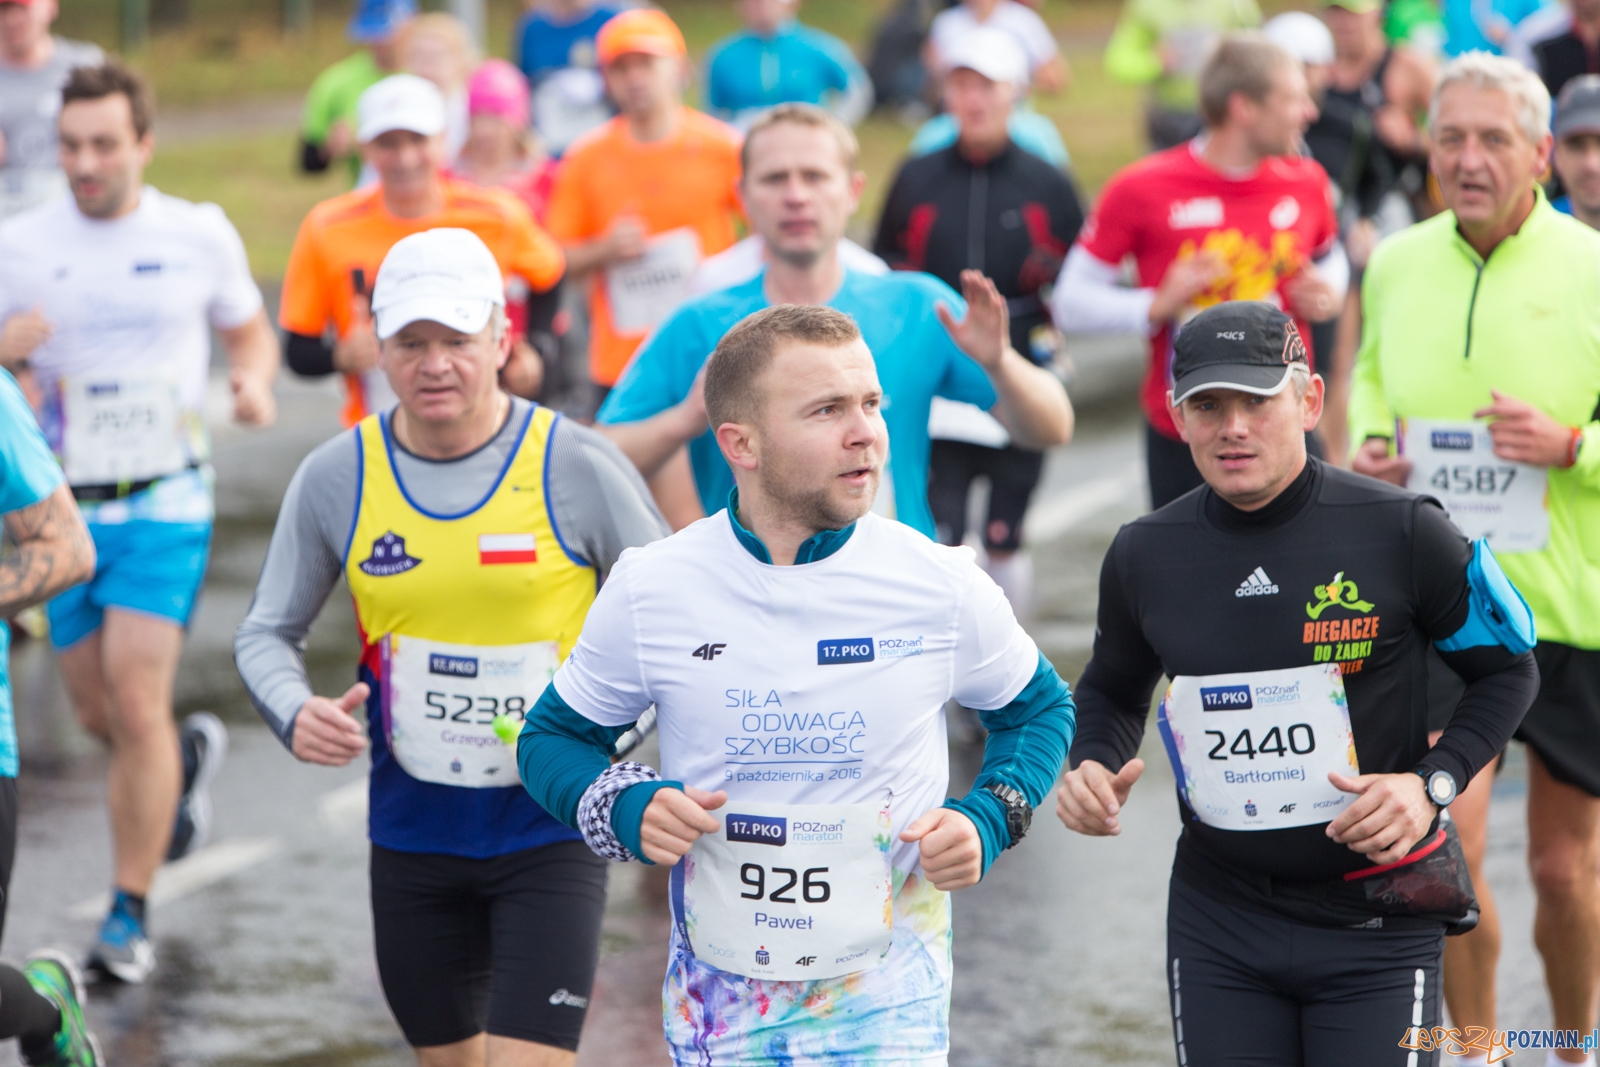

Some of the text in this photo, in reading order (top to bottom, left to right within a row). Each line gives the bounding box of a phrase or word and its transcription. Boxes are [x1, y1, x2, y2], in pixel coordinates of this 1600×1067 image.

[1430, 465, 1517, 495] 4587
[1235, 584, 1279, 598] adidas
[1302, 616, 1380, 644] BIEGACZE
[692, 643, 727, 661] 4F
[1313, 640, 1373, 662] DO ŻABKI
[425, 691, 525, 725] 5238
[725, 689, 782, 708] SIŁA
[742, 710, 866, 732] ODWAGA
[725, 731, 866, 756] SZYBKOŚĆ
[1204, 723, 1317, 761] 2440
[724, 768, 862, 783] 9 października 2016
[1224, 767, 1306, 784] Bartłomiej
[1279, 803, 1298, 814] 4F
[792, 831, 844, 841] maraton
[740, 862, 831, 904] 926
[754, 912, 814, 930] Paweł
[795, 955, 818, 966] 4F
